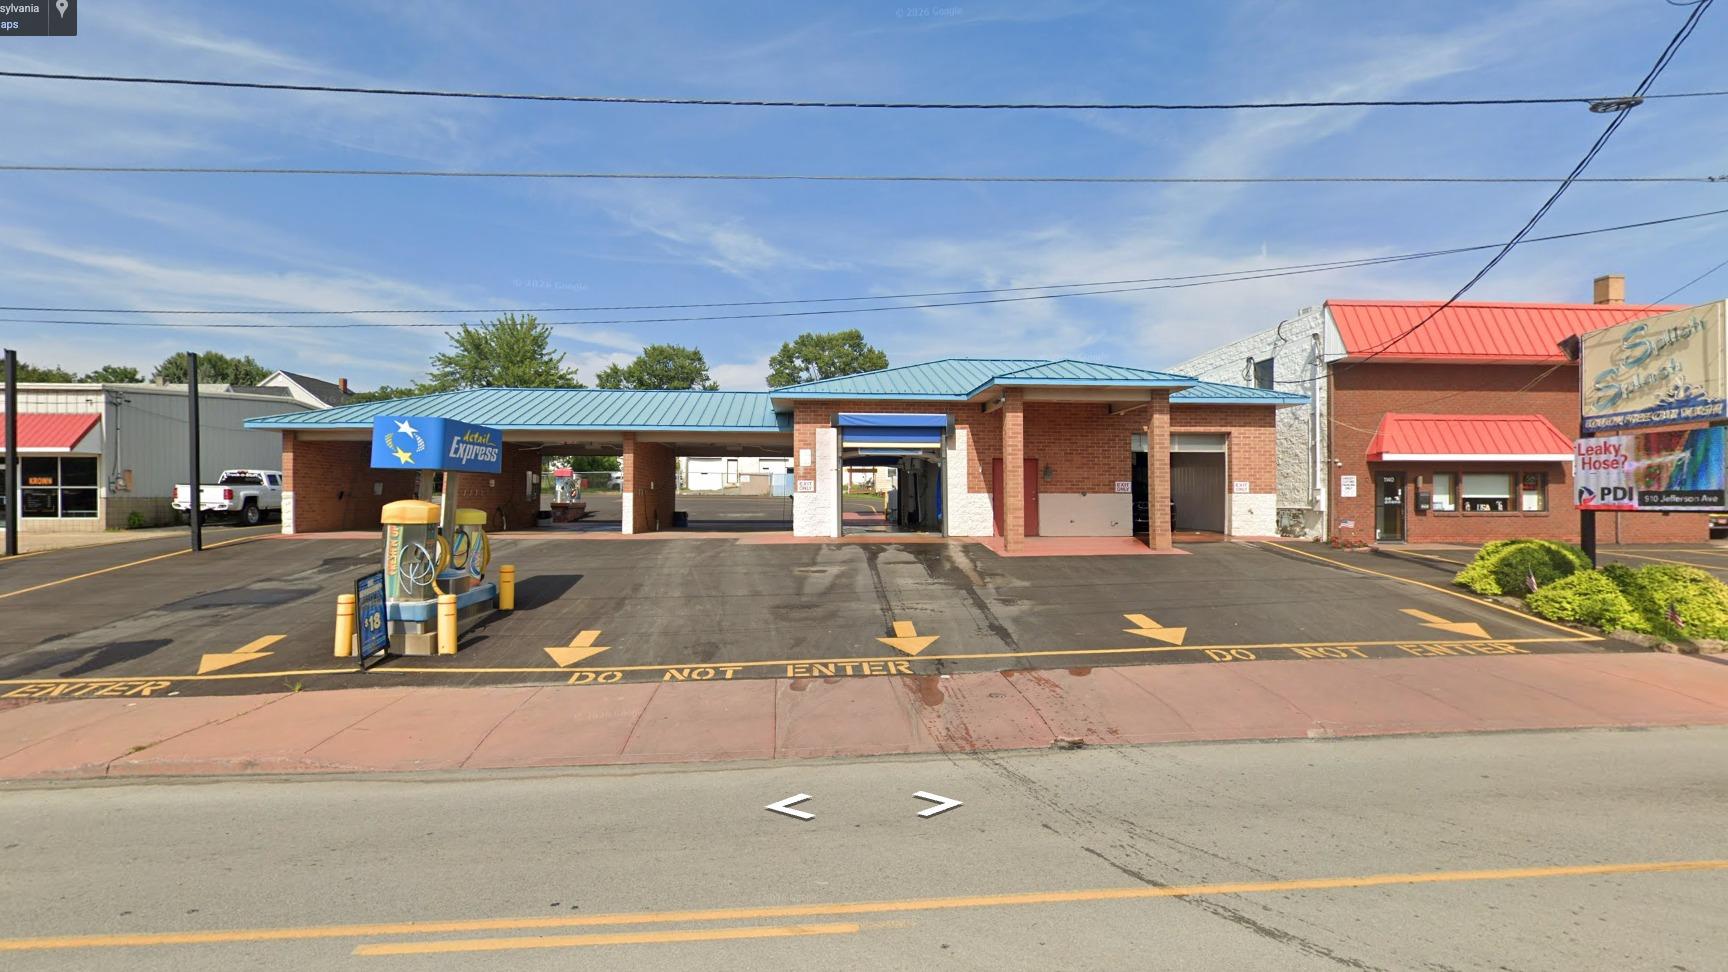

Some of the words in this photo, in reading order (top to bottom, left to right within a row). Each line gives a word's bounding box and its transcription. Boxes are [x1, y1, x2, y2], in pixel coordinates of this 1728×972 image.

[1591, 358, 1682, 411] Splash
[463, 430, 496, 446] detail
[449, 436, 499, 465] Express
[1577, 441, 1621, 457] Leaky
[1581, 455, 1628, 471] Hose?
[1600, 487, 1634, 501] PDI
[1660, 494, 1699, 503] Jefferson
[1701, 494, 1719, 503] Ave
[1203, 648, 1257, 662] DO
[1290, 645, 1368, 659] NOT
[1396, 642, 1531, 657] ENTER
[568, 671, 623, 684] DO
[663, 666, 744, 681] NOT
[786, 660, 914, 678] ENTER
[1, 681, 171, 698] ENTER
